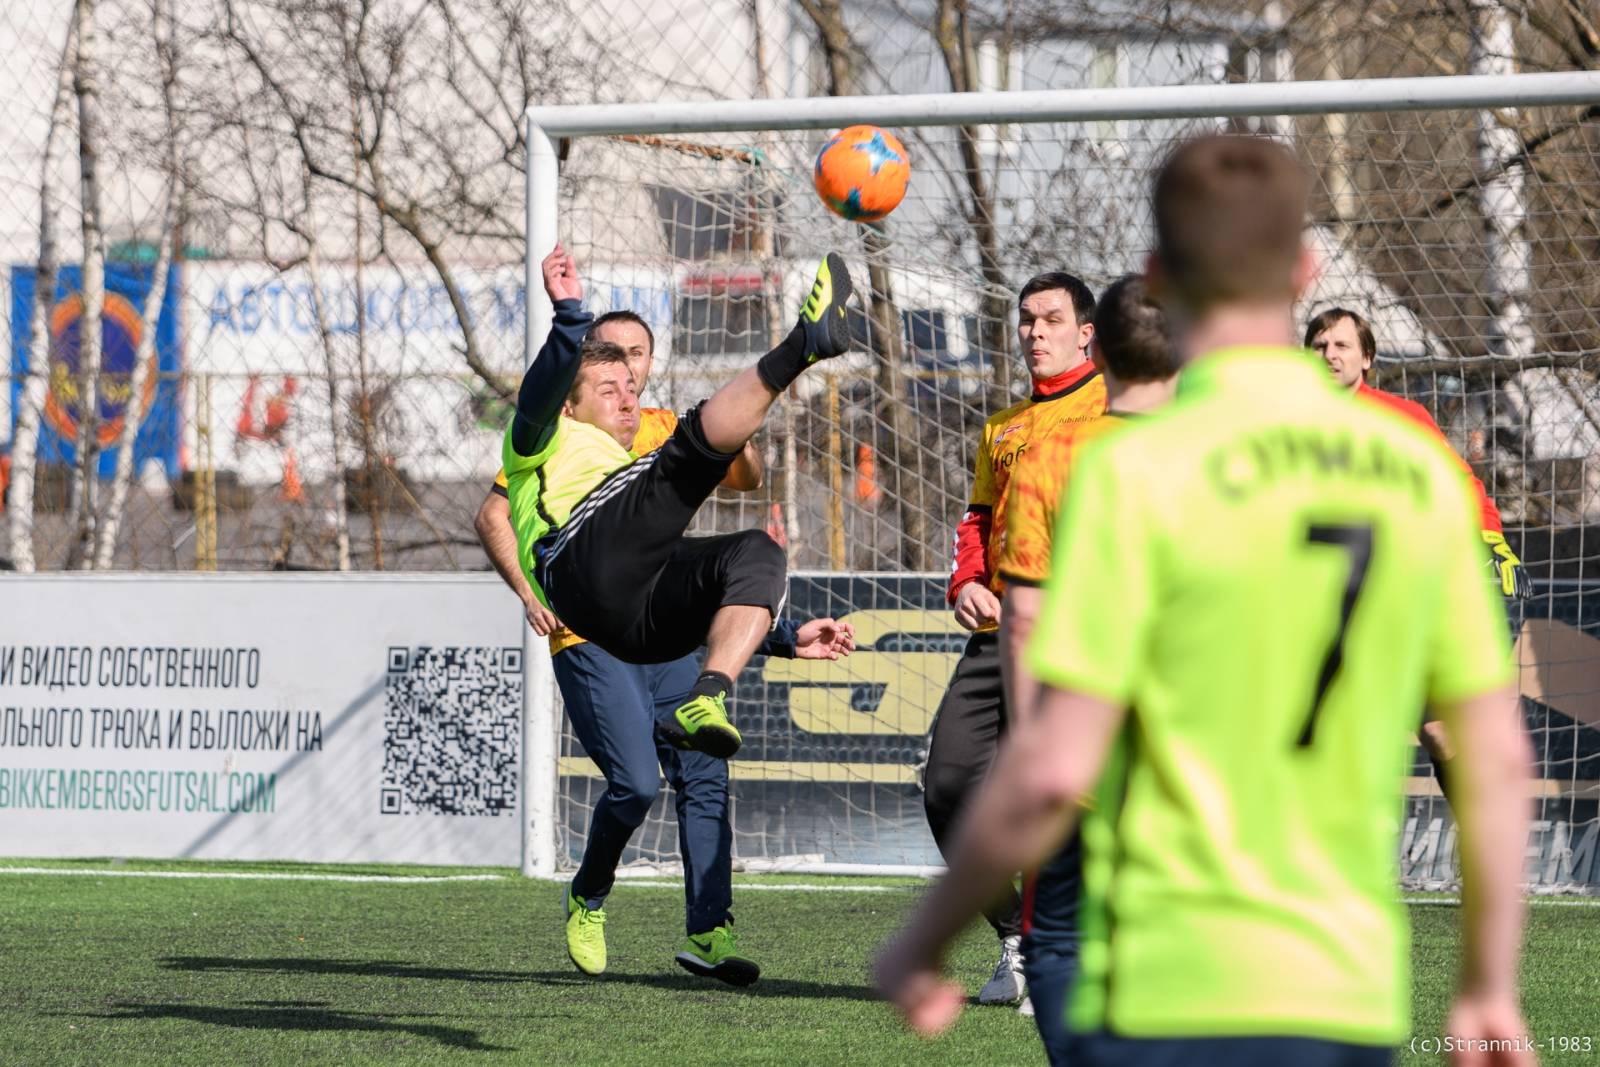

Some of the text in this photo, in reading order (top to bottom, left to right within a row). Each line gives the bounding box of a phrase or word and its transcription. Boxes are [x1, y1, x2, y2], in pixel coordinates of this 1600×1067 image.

[1296, 519, 1376, 749] 7
[20, 645, 93, 692] ВИДЕО
[98, 646, 261, 689] СОБСТВЕННОГО
[0, 707, 324, 752] ЛЬНОГО ТРЮКА И ВЫЛОЖИ НА
[0, 768, 277, 814] BIKKEMBERGSFUTSAL.COM
